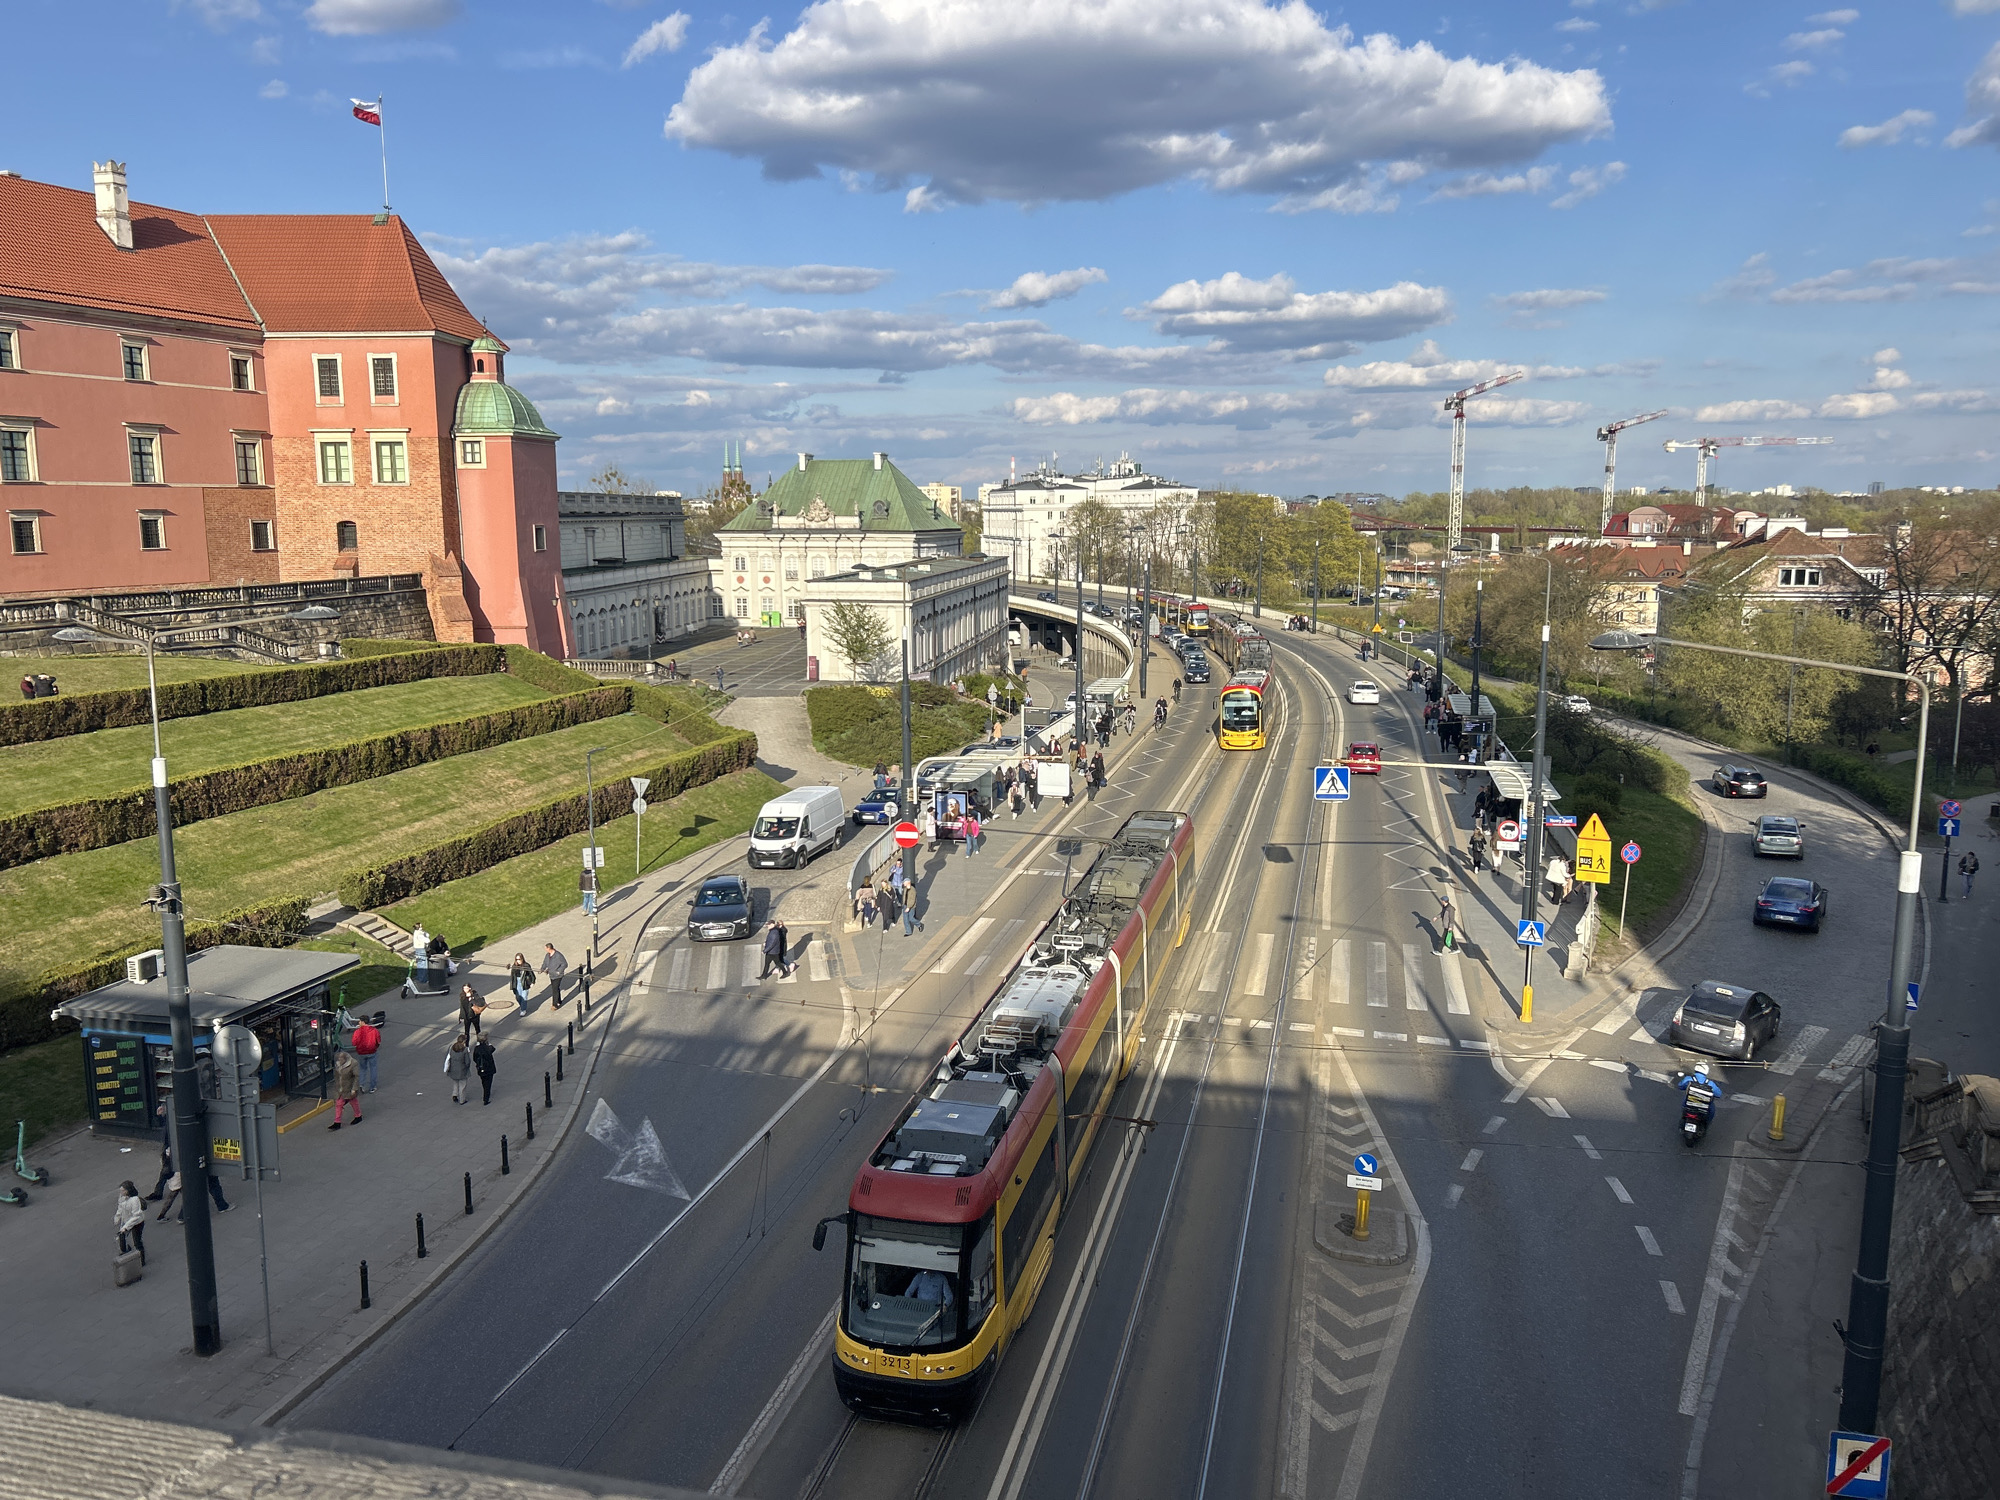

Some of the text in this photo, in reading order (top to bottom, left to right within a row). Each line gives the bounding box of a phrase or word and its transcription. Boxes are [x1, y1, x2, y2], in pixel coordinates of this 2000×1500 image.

[94, 1050, 118, 1060] SOUVENIRS
[96, 1066, 112, 1074] DRINKS
[96, 1081, 120, 1090] CIGARETTES
[124, 1086, 138, 1095] BILETY
[98, 1097, 115, 1105] TICKETS
[100, 1111, 116, 1120] SNACKS
[214, 1138, 228, 1146] SKUP
[880, 1356, 910, 1370] 3213
